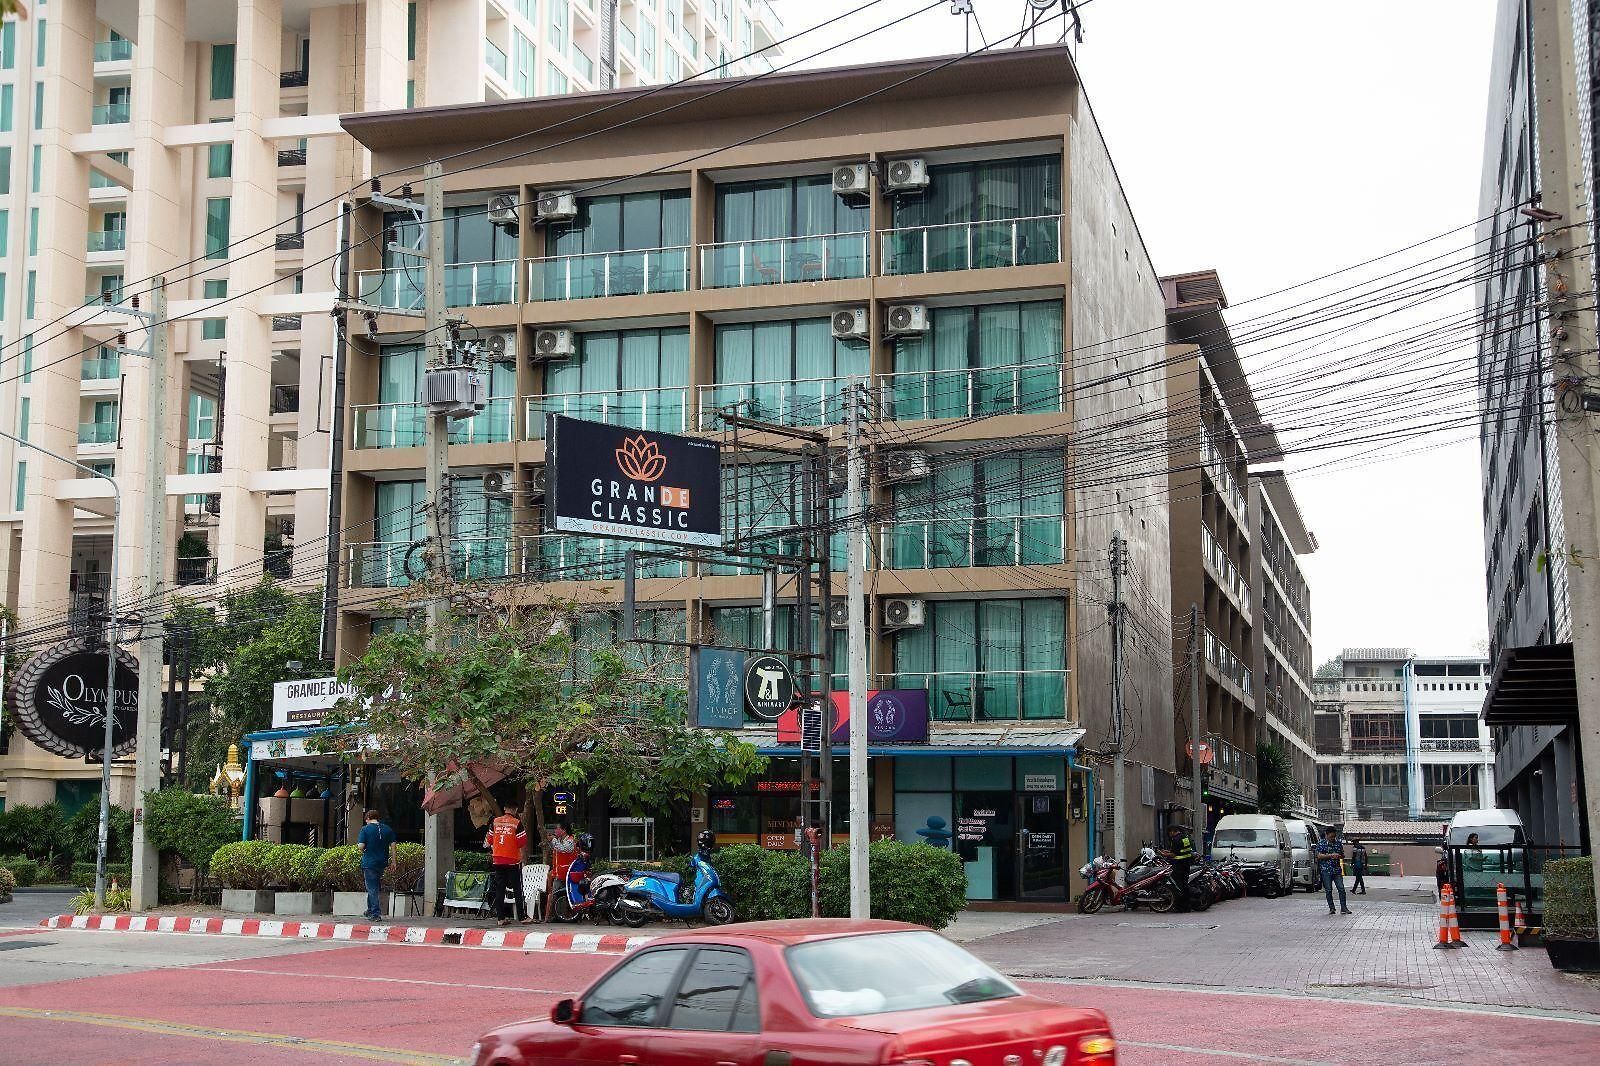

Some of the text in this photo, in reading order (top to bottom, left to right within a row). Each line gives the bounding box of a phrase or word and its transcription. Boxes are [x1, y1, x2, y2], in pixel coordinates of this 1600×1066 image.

[591, 478, 689, 508] GRANDE
[591, 501, 688, 528] CLASSIC
[287, 681, 327, 699] GRANDE
